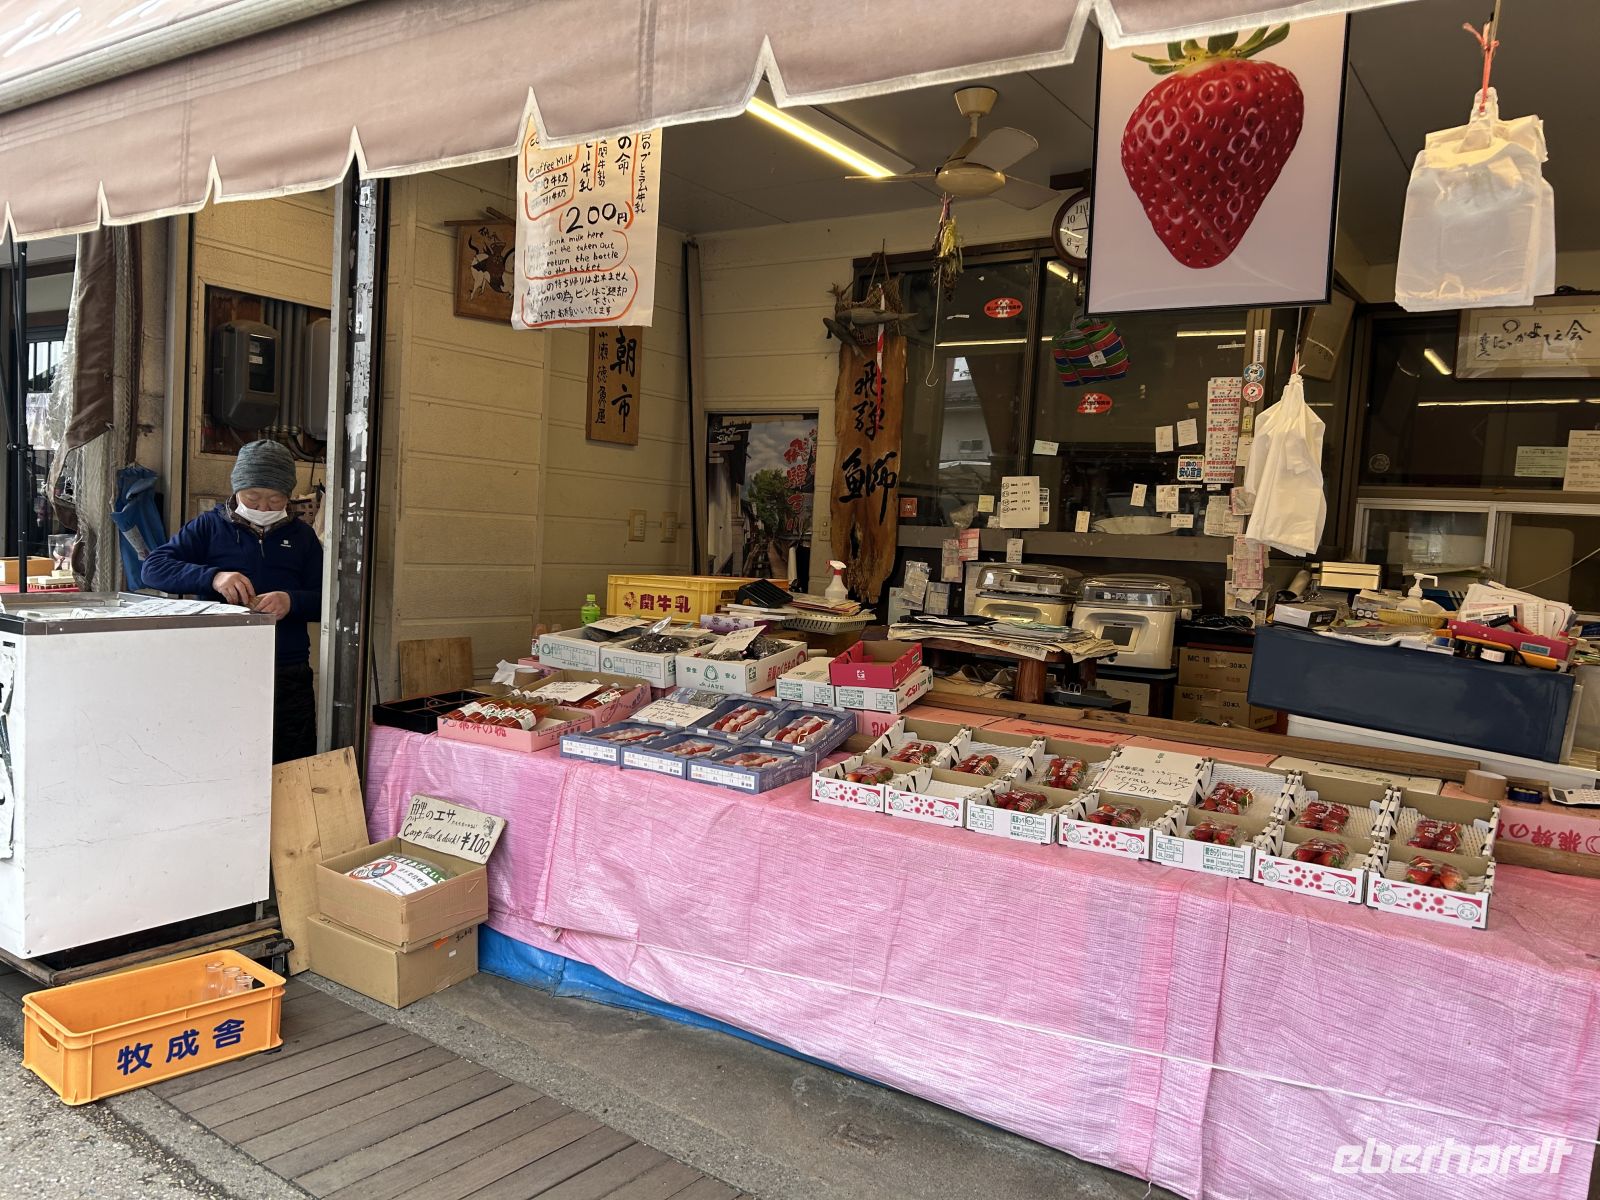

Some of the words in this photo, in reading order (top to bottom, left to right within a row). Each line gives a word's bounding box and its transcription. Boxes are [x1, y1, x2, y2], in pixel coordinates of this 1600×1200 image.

[528, 161, 555, 178] Coffee
[556, 153, 573, 167] Milk
[568, 234, 584, 243] milk
[587, 230, 604, 239] here
[560, 244, 571, 253] the
[576, 242, 598, 252] taken
[546, 257, 570, 267] return
[575, 253, 590, 262] the
[593, 250, 619, 261] bottle
[555, 265, 566, 274] the
[569, 263, 601, 272] basket
[593, 297, 616, 306] 下さい
[609, 328, 638, 433] 朝市
[640, 593, 692, 614] 関牛乳
[406, 799, 457, 823] 鯉のエサ
[403, 823, 423, 841] Carp
[460, 831, 491, 856] ¥100
[116, 1018, 245, 1076] 牧成舎
